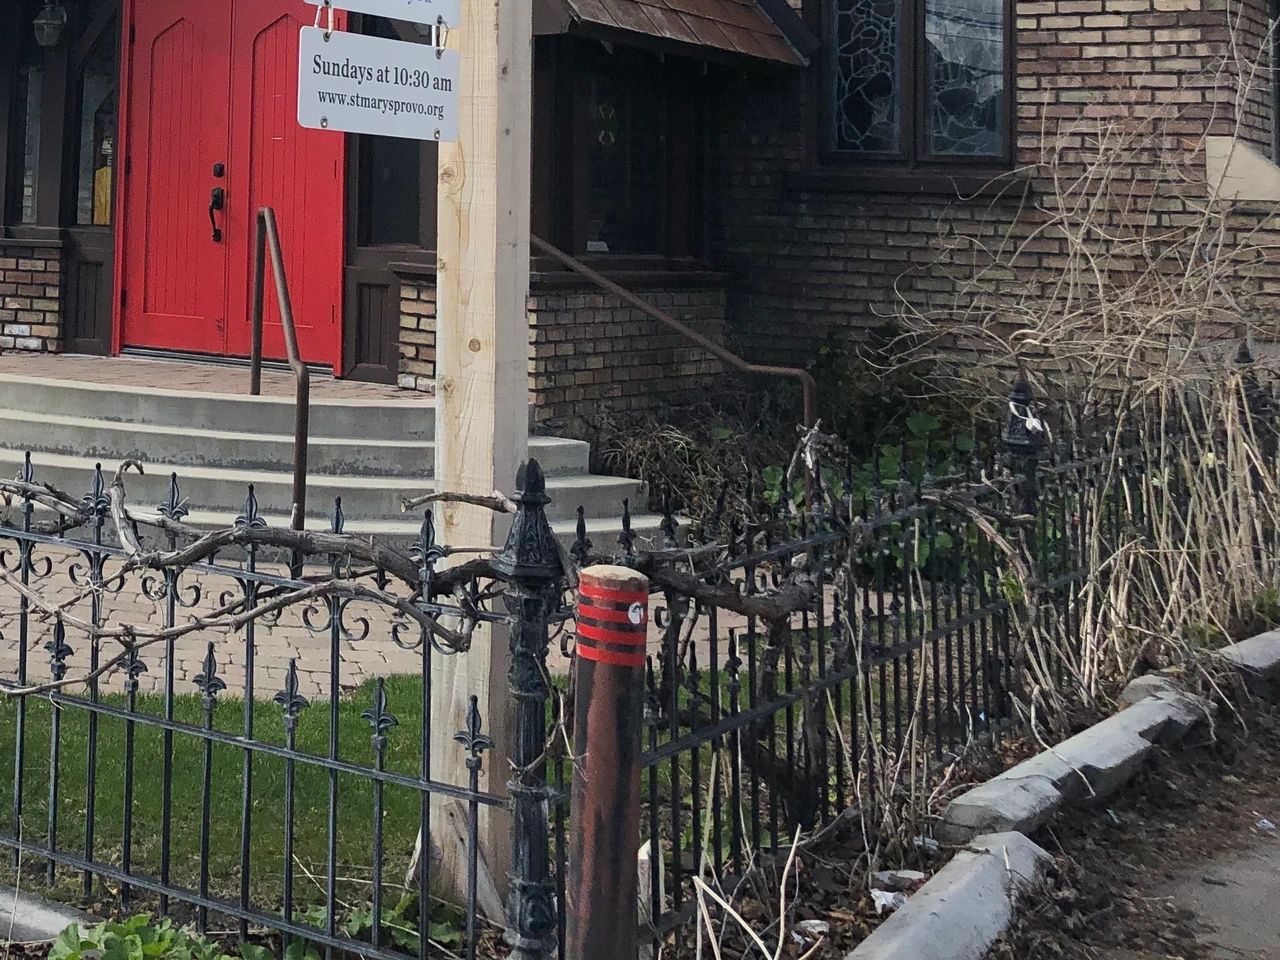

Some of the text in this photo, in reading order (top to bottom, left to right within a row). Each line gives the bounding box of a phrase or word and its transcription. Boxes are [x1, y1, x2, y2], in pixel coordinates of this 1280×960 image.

[312, 54, 452, 92] Sundays at 10:30 am
[317, 89, 444, 120] www.stmarysprovo.org
